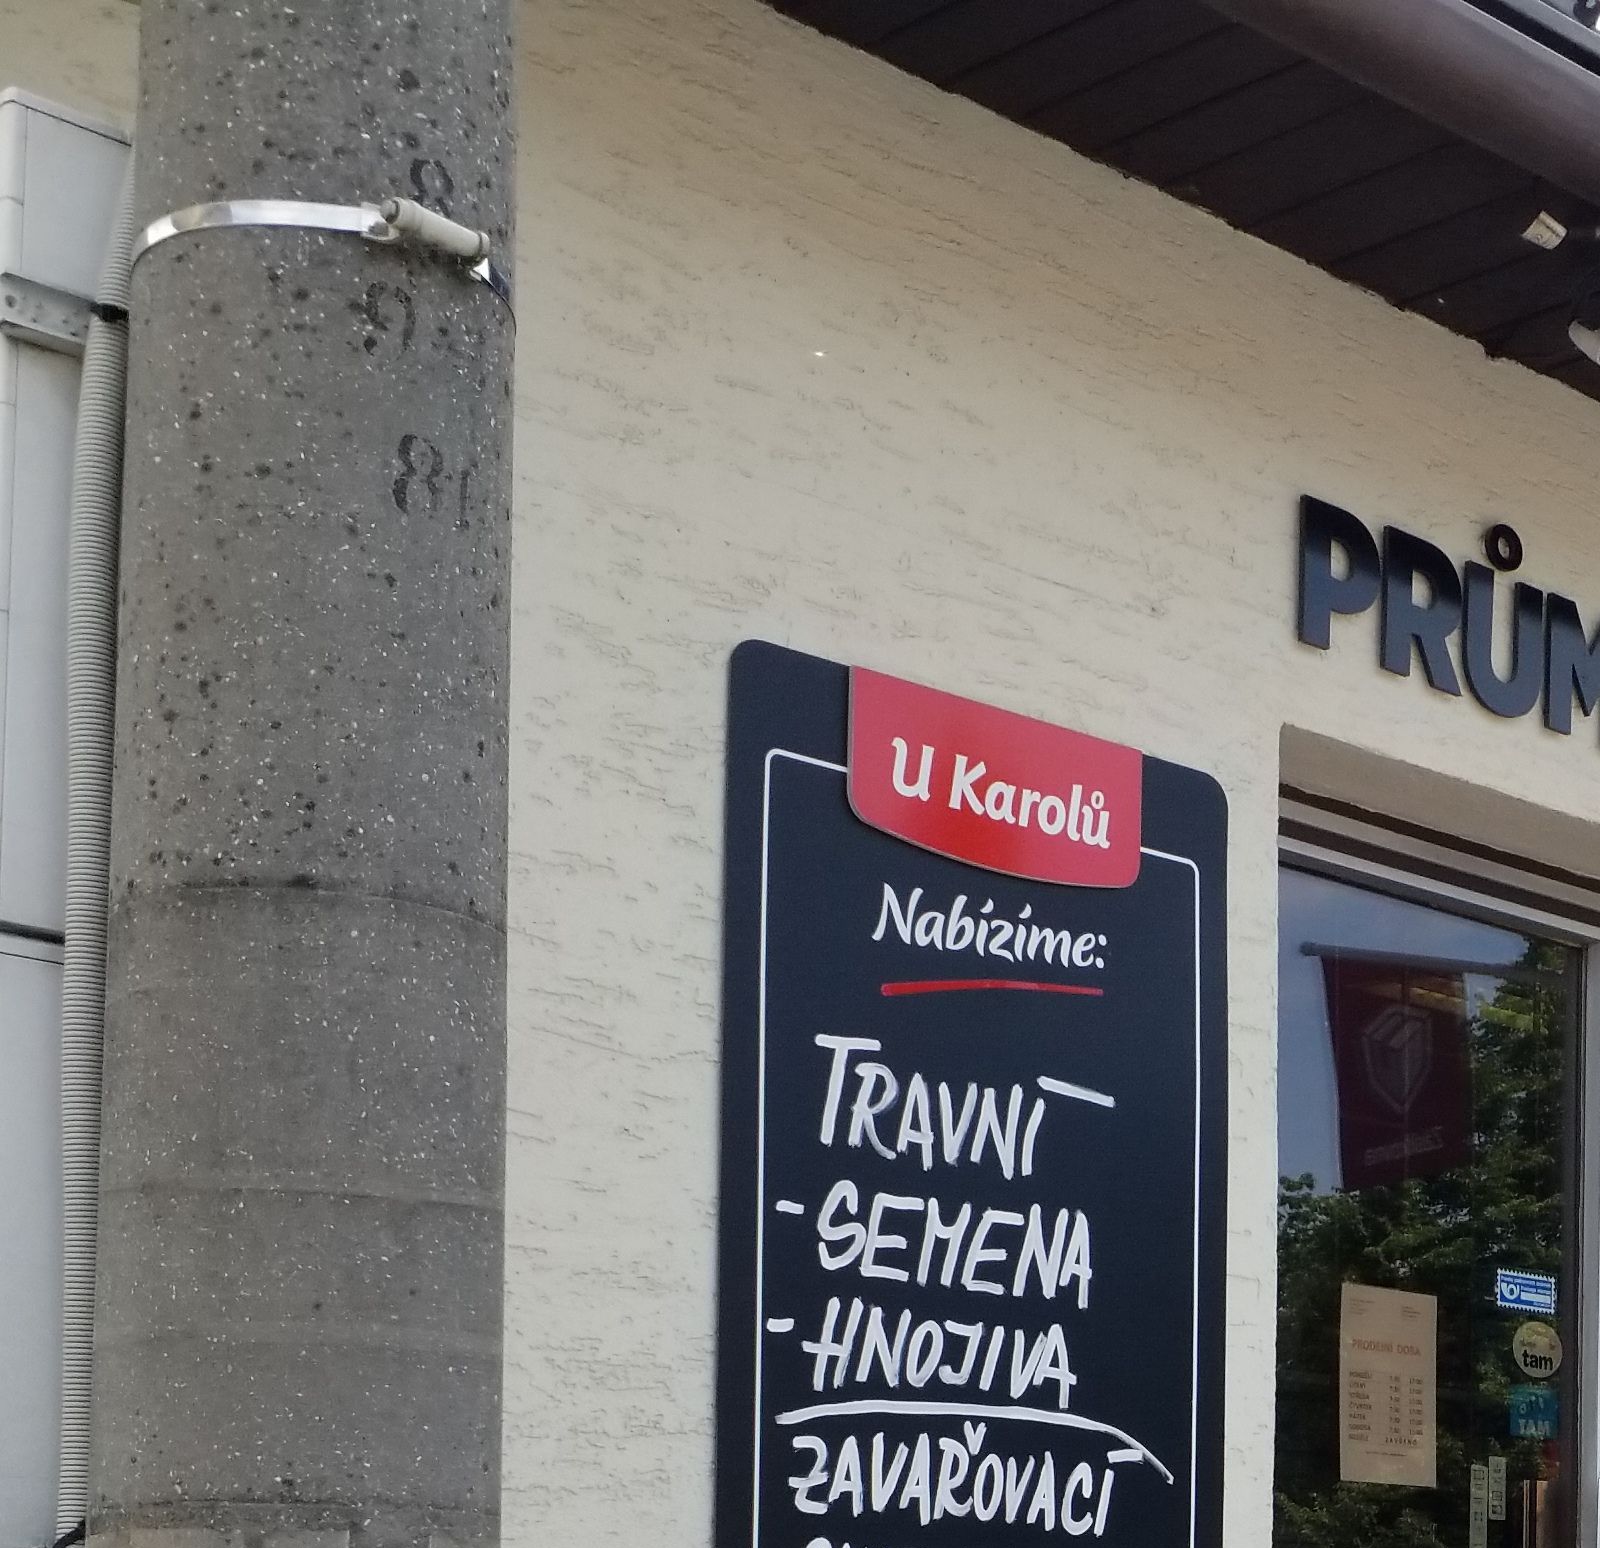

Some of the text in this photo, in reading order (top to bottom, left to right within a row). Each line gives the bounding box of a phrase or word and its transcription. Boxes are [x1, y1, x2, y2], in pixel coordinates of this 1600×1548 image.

[891, 737, 1111, 849] U Karolů
[872, 882, 1107, 969] Nabízíme:
[814, 1033, 1115, 1180] TRAVNÍ
[1522, 1350, 1554, 1371] tam
[787, 1422, 1144, 1536] ZAVAŘOVACÍ
